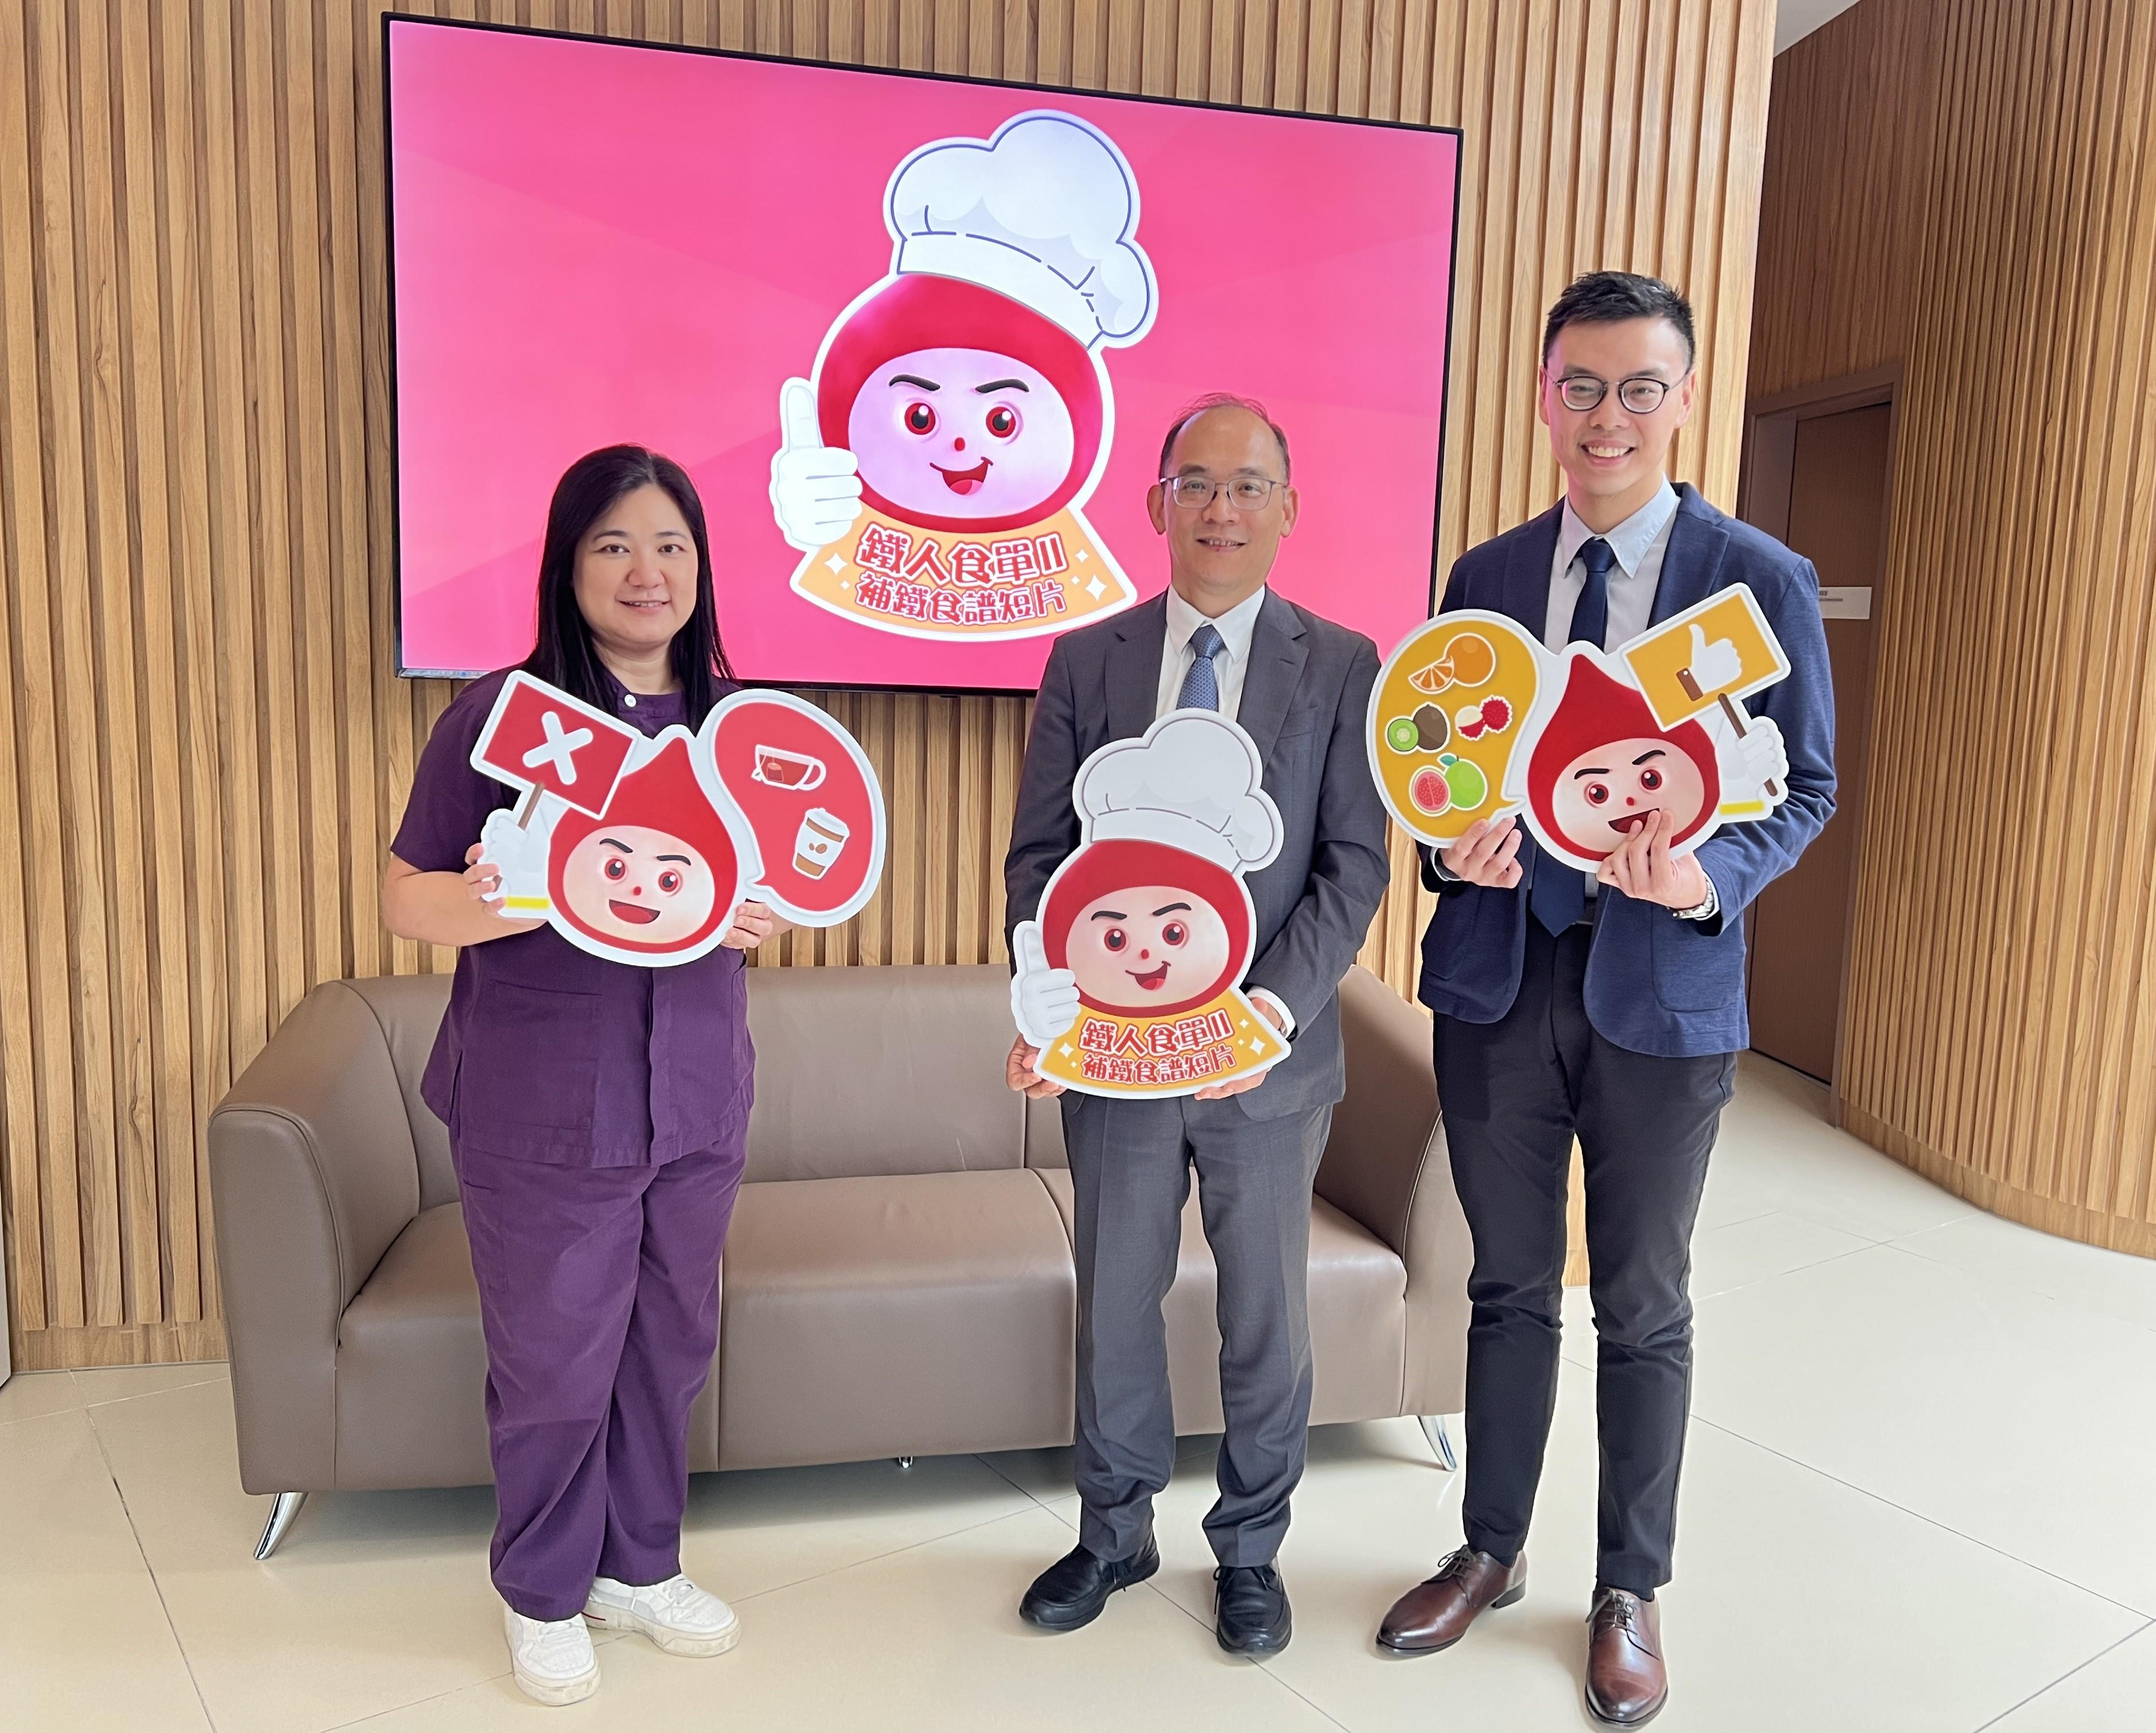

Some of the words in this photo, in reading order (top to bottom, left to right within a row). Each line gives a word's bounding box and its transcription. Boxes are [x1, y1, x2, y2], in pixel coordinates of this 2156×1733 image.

[857, 572, 1066, 624] 補鐵食譜短片
[1083, 1044, 1235, 1084] 補鐵食譜短片
